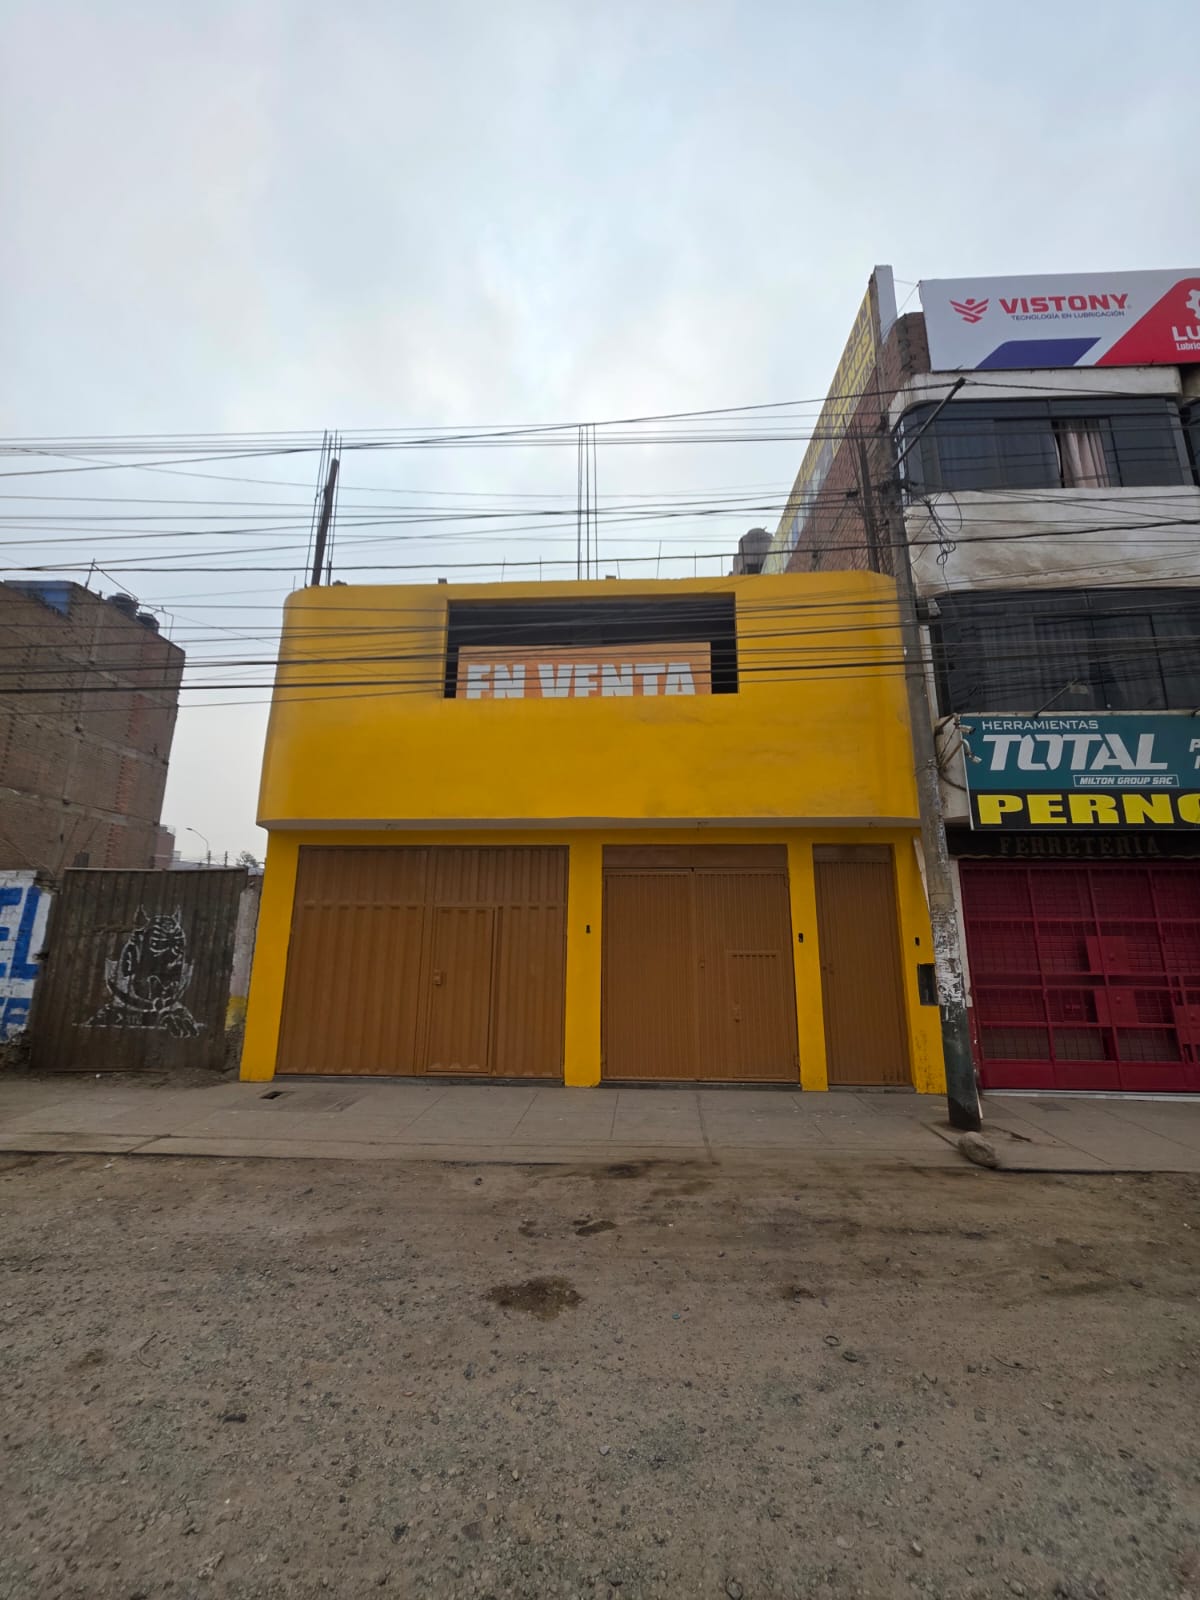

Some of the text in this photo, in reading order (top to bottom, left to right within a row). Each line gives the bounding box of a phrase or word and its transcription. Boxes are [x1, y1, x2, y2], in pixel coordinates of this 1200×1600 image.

[999, 293, 1128, 314] VISTONY
[466, 662, 696, 699] EN VENTA
[982, 719, 1099, 731] HERRAMIENTAS
[983, 733, 1168, 770] TOTAL
[1079, 776, 1174, 785] MILTON GROUP SAC
